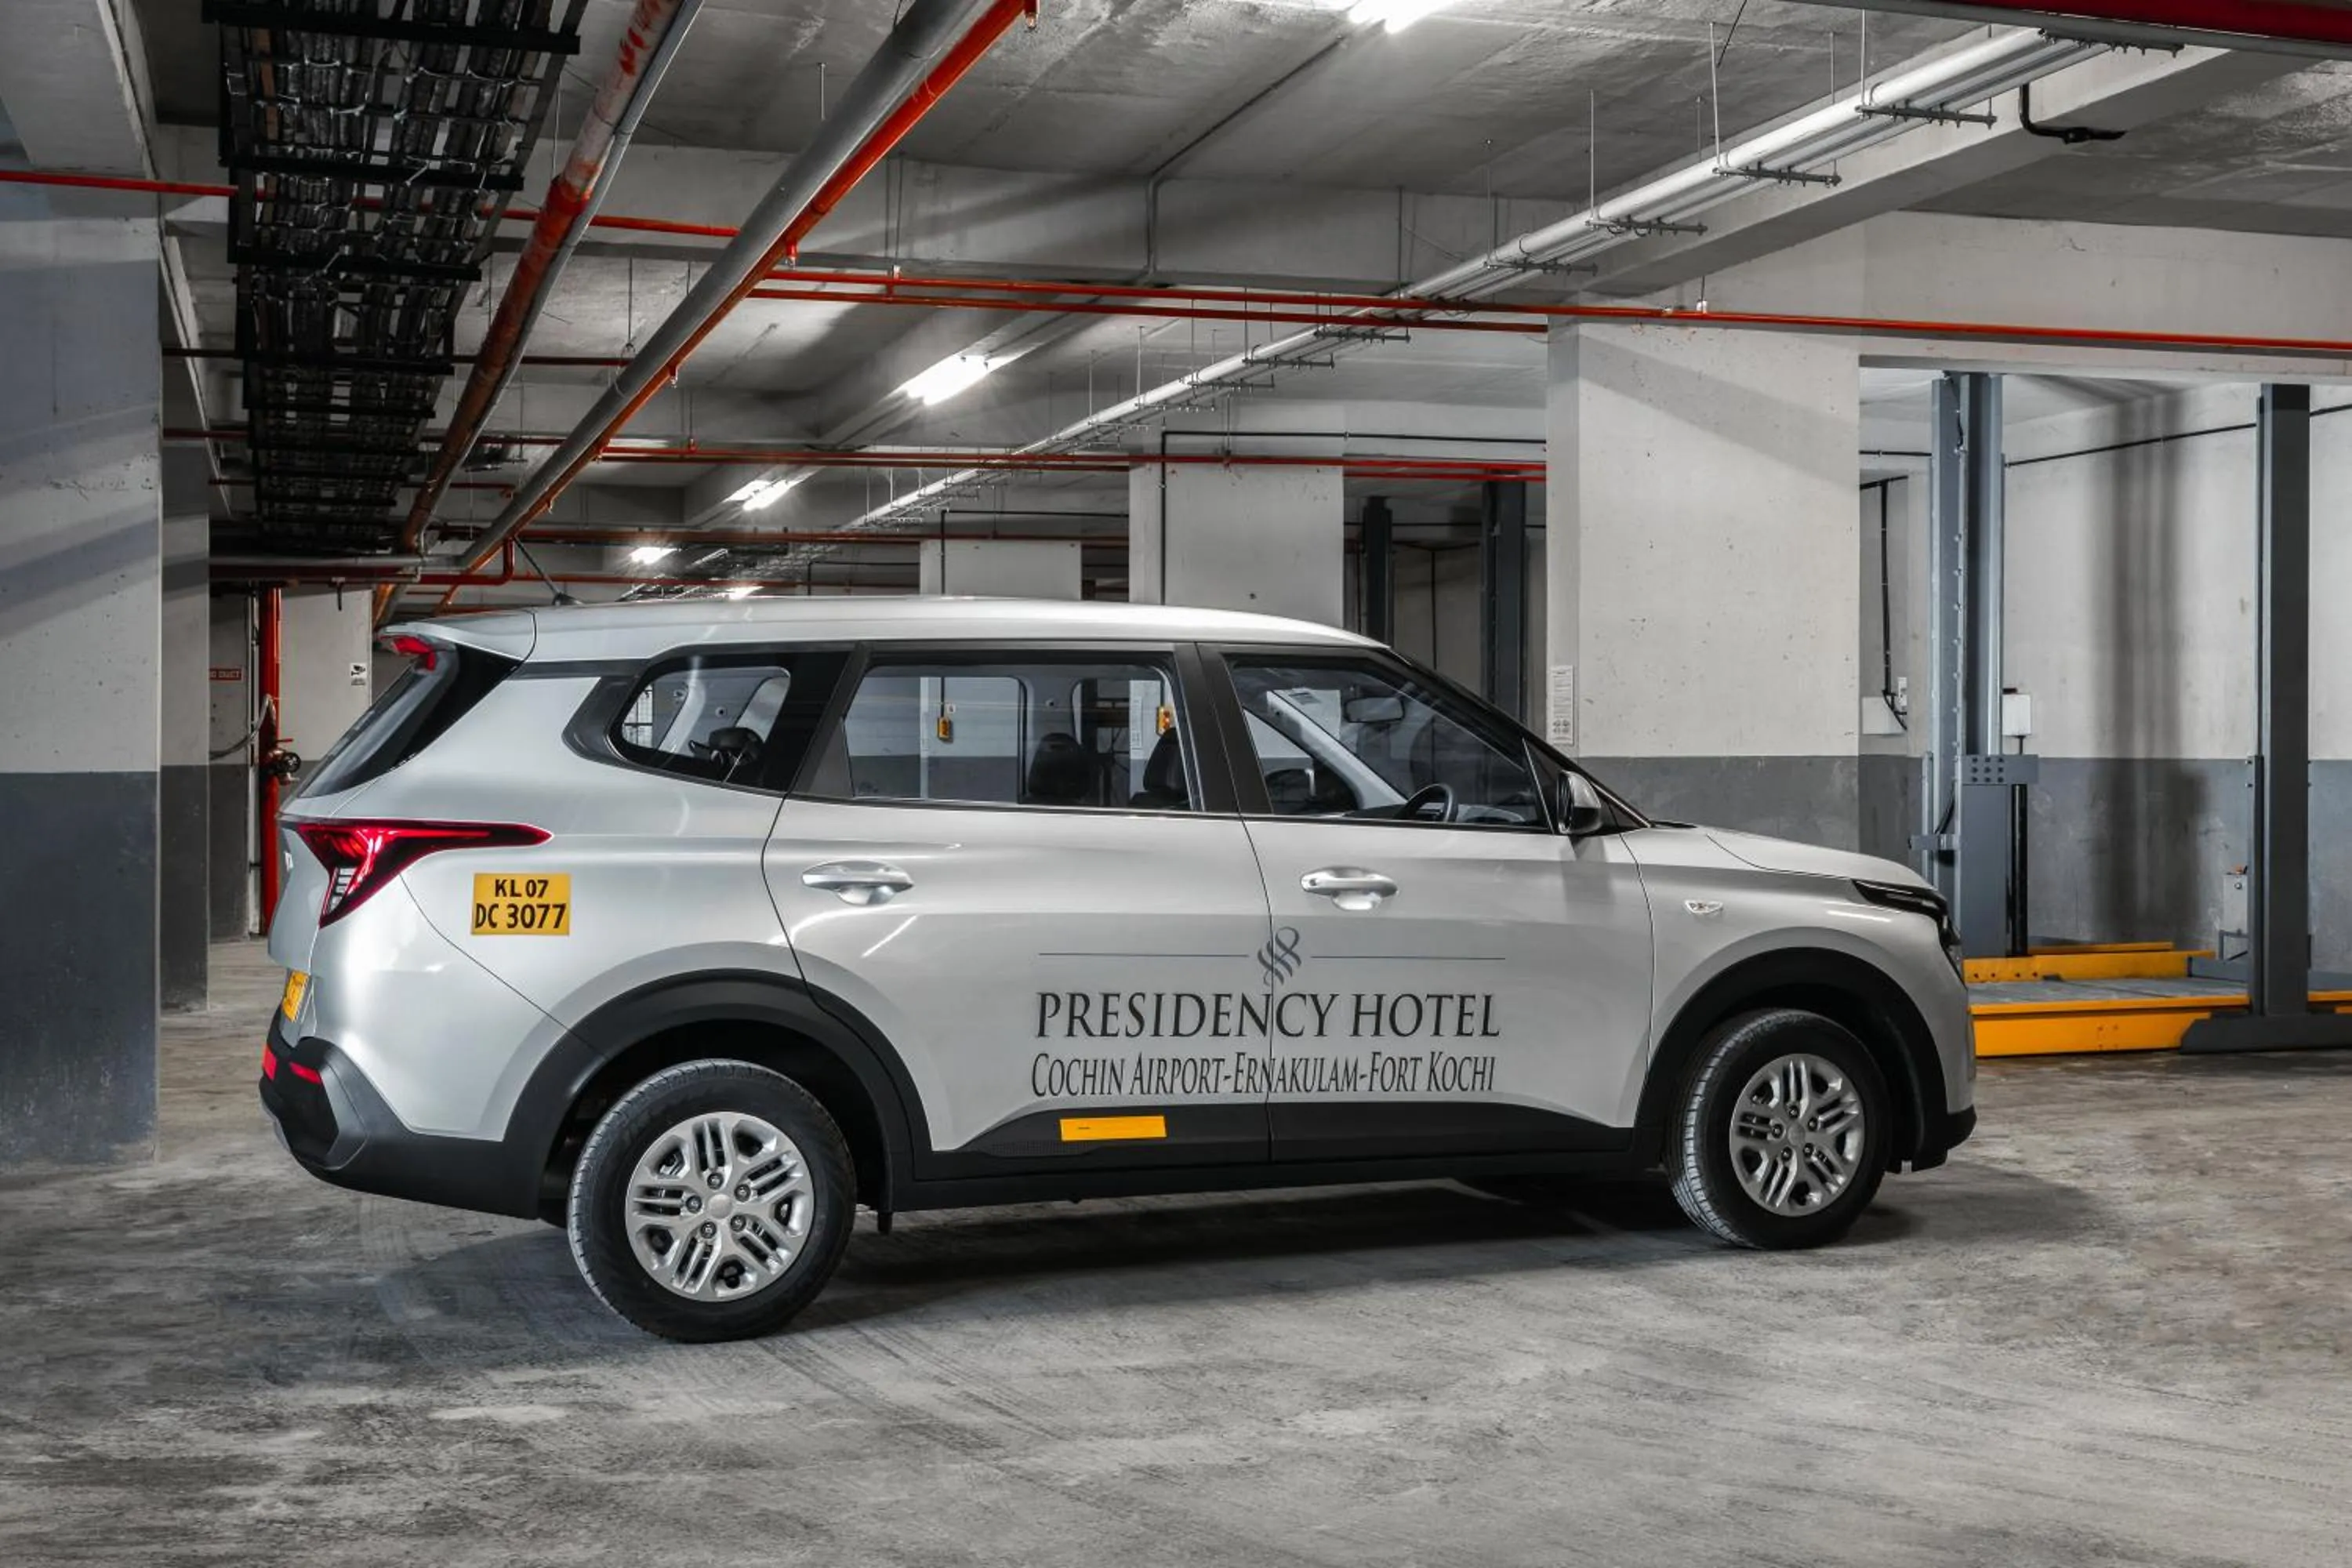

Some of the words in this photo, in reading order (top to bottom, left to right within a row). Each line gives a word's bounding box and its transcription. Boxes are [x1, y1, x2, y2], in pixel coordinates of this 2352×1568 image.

[474, 903, 499, 929] DC
[506, 902, 567, 929] 3077
[1036, 991, 1340, 1038] PRESIDENCY
[1348, 993, 1501, 1037] HOTEL
[1031, 1053, 1125, 1098] COCHIN
[1426, 1051, 1495, 1093] KOCHI
